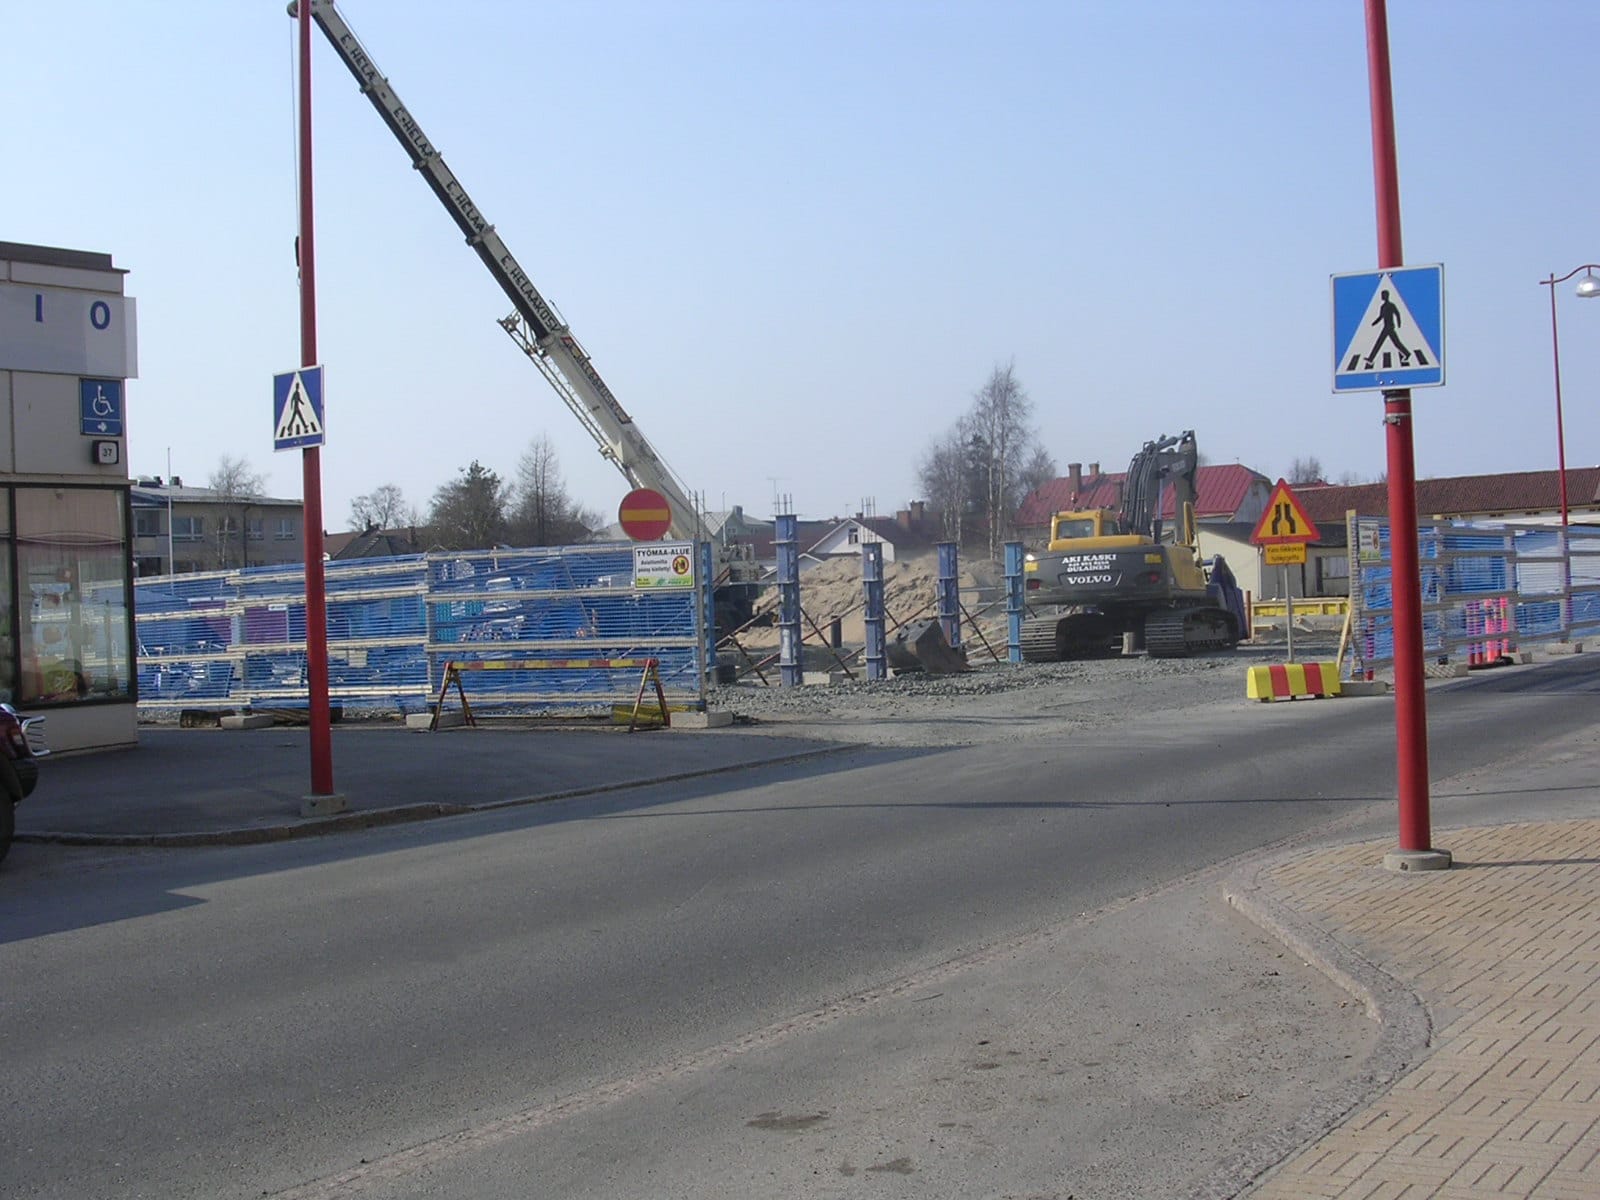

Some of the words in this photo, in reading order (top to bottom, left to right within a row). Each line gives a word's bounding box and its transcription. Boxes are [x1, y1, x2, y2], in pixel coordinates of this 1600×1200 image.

[637, 547, 690, 557] TYÖMAA-ALUE
[1062, 555, 1081, 564] AKI
[1082, 553, 1117, 562] KASKI
[1067, 574, 1112, 585] VOLVO
